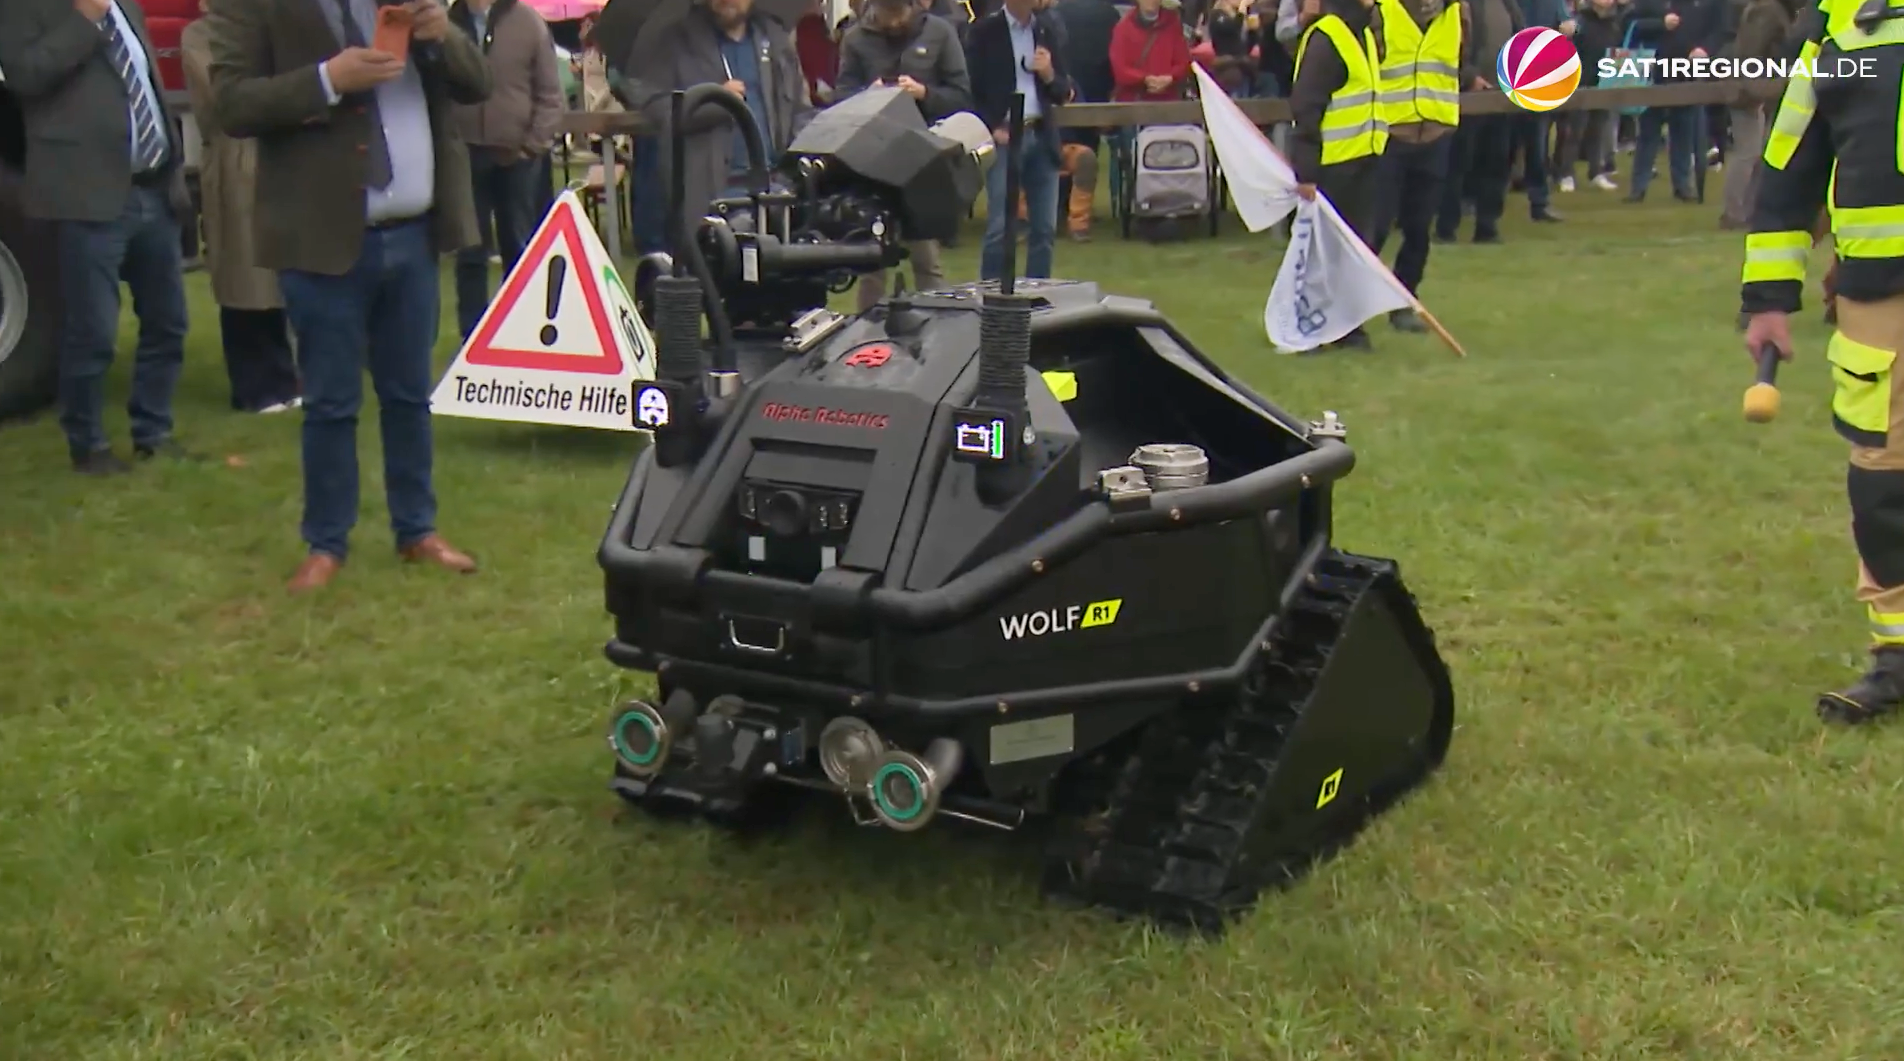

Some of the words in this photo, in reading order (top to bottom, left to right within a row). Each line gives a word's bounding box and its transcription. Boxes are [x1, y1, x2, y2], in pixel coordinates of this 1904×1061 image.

[455, 375, 573, 411] Technische
[579, 385, 628, 416] Hilfe
[762, 402, 812, 421] Alpha
[815, 406, 890, 429] Robotics
[999, 604, 1081, 640] WOLF
[1093, 605, 1110, 622] R1
